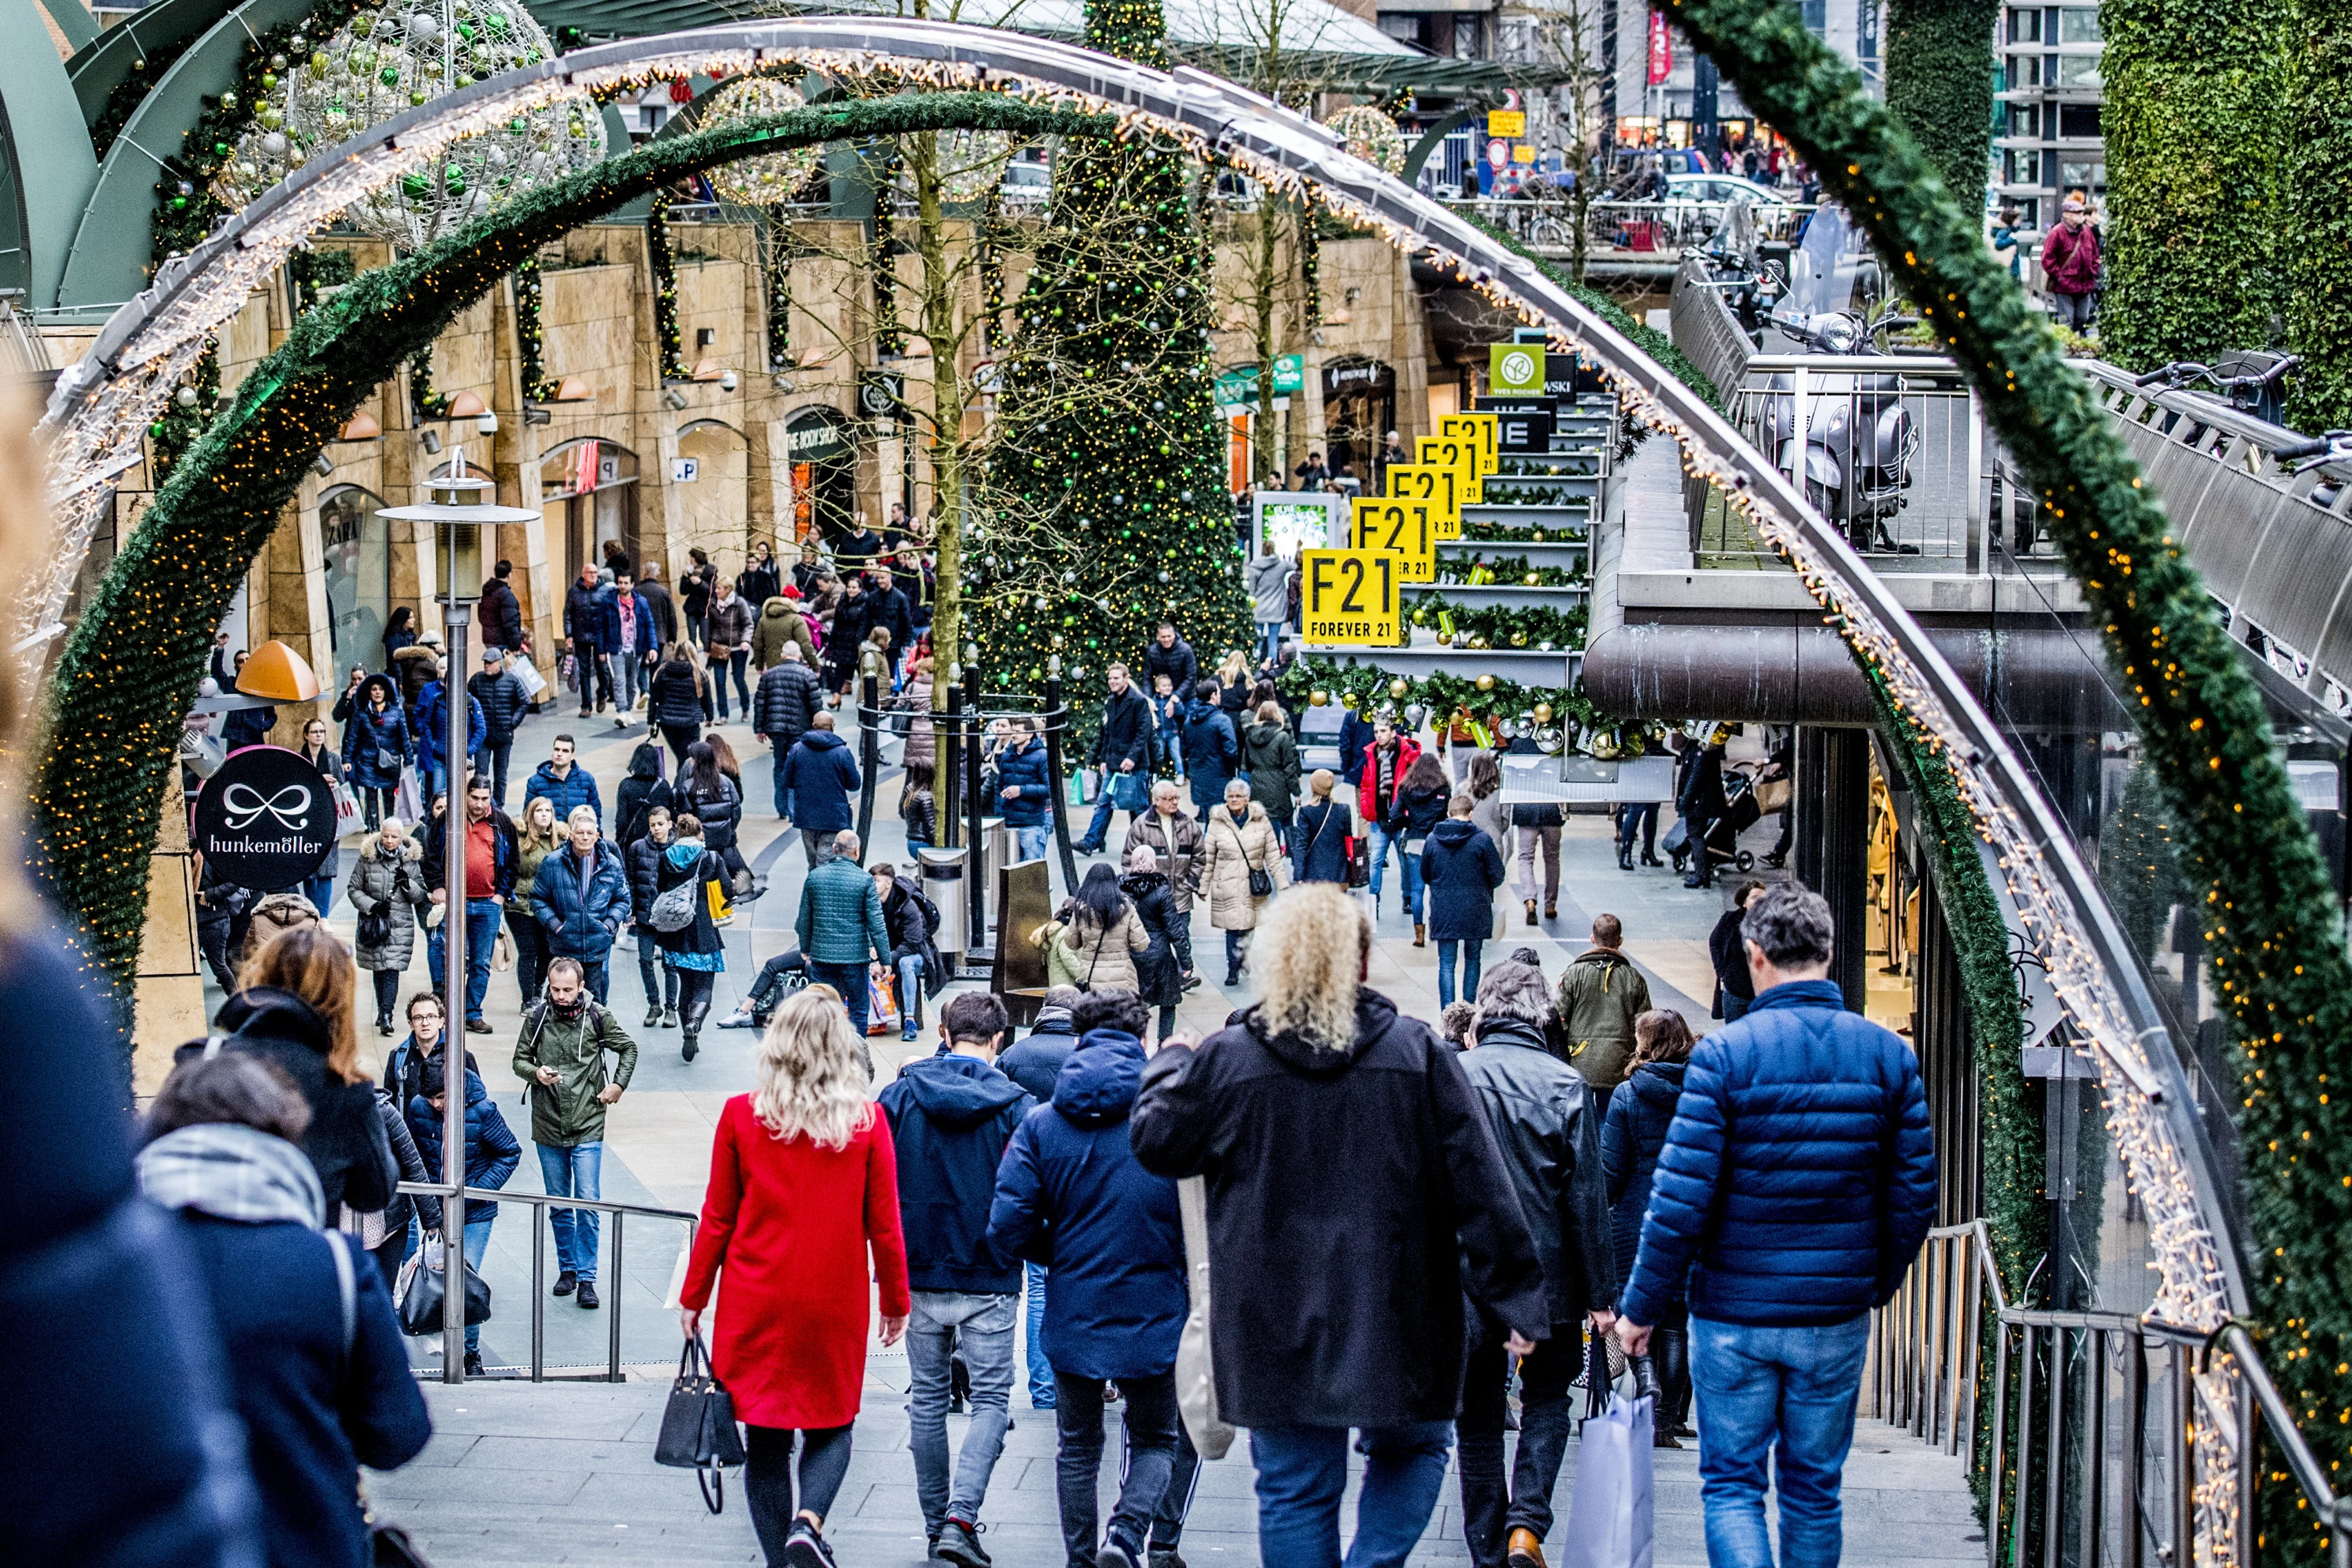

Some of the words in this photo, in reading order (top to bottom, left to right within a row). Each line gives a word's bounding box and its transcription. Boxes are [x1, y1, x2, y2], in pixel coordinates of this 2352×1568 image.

[786, 432, 799, 451] THE
[799, 428, 819, 450] BODY
[685, 464, 694, 479] P
[1483, 460, 1493, 469] 21
[1467, 488, 1476, 497] 21
[328, 519, 358, 546] ZARA
[1359, 506, 1427, 554] F21
[1444, 522, 1453, 533] 21
[1415, 562, 1427, 575] 21
[1311, 557, 1390, 612] F21
[1311, 622, 1370, 636] FOREVER
[1377, 623, 1390, 637] 21
